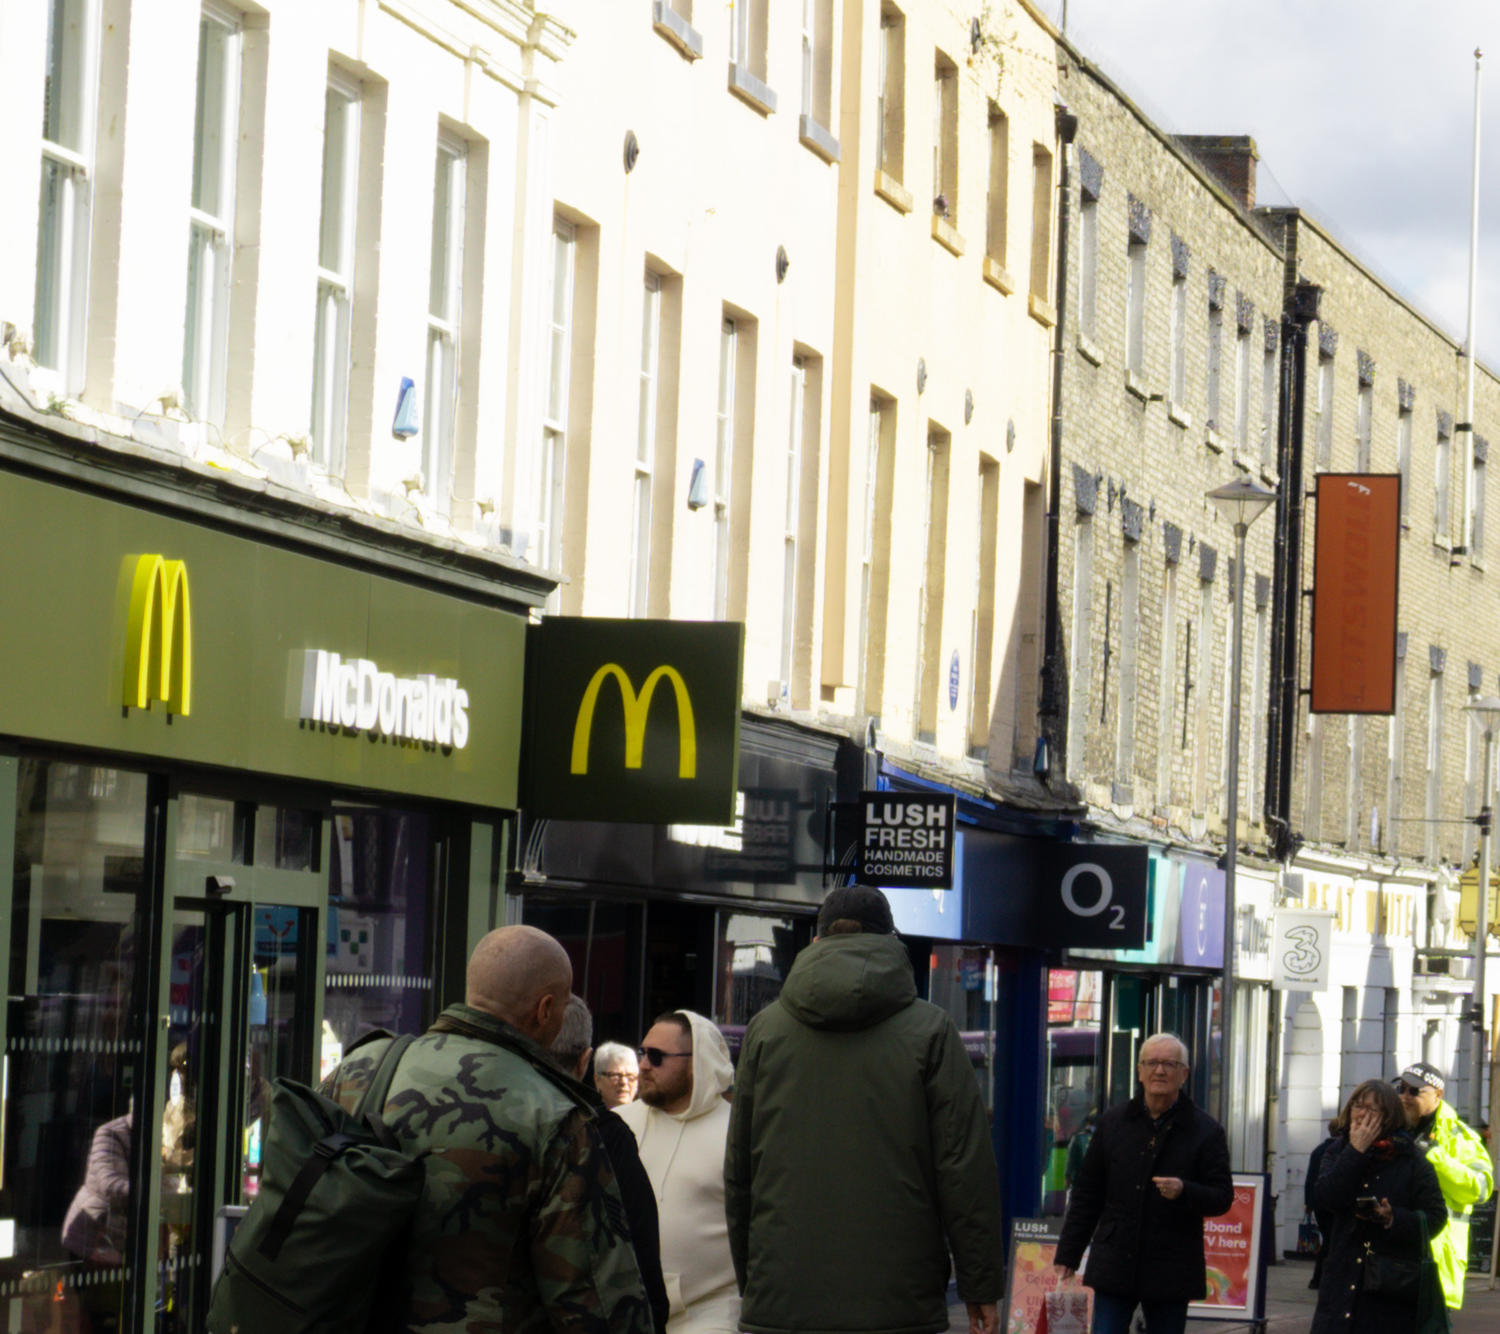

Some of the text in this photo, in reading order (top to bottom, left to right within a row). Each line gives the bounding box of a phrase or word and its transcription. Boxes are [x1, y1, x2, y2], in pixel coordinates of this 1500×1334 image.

[306, 648, 470, 750] McDonald's
[866, 803, 946, 827] LUSH
[865, 828, 945, 849] FRESH
[865, 850, 944, 863] HANDMADE
[864, 864, 944, 877] COSMETICS
[1294, 880, 1356, 935] REAT
[1284, 975, 1320, 984] Three.co.uk
[1014, 1222, 1049, 1233] LUSH
[1218, 1236, 1247, 1249] here
